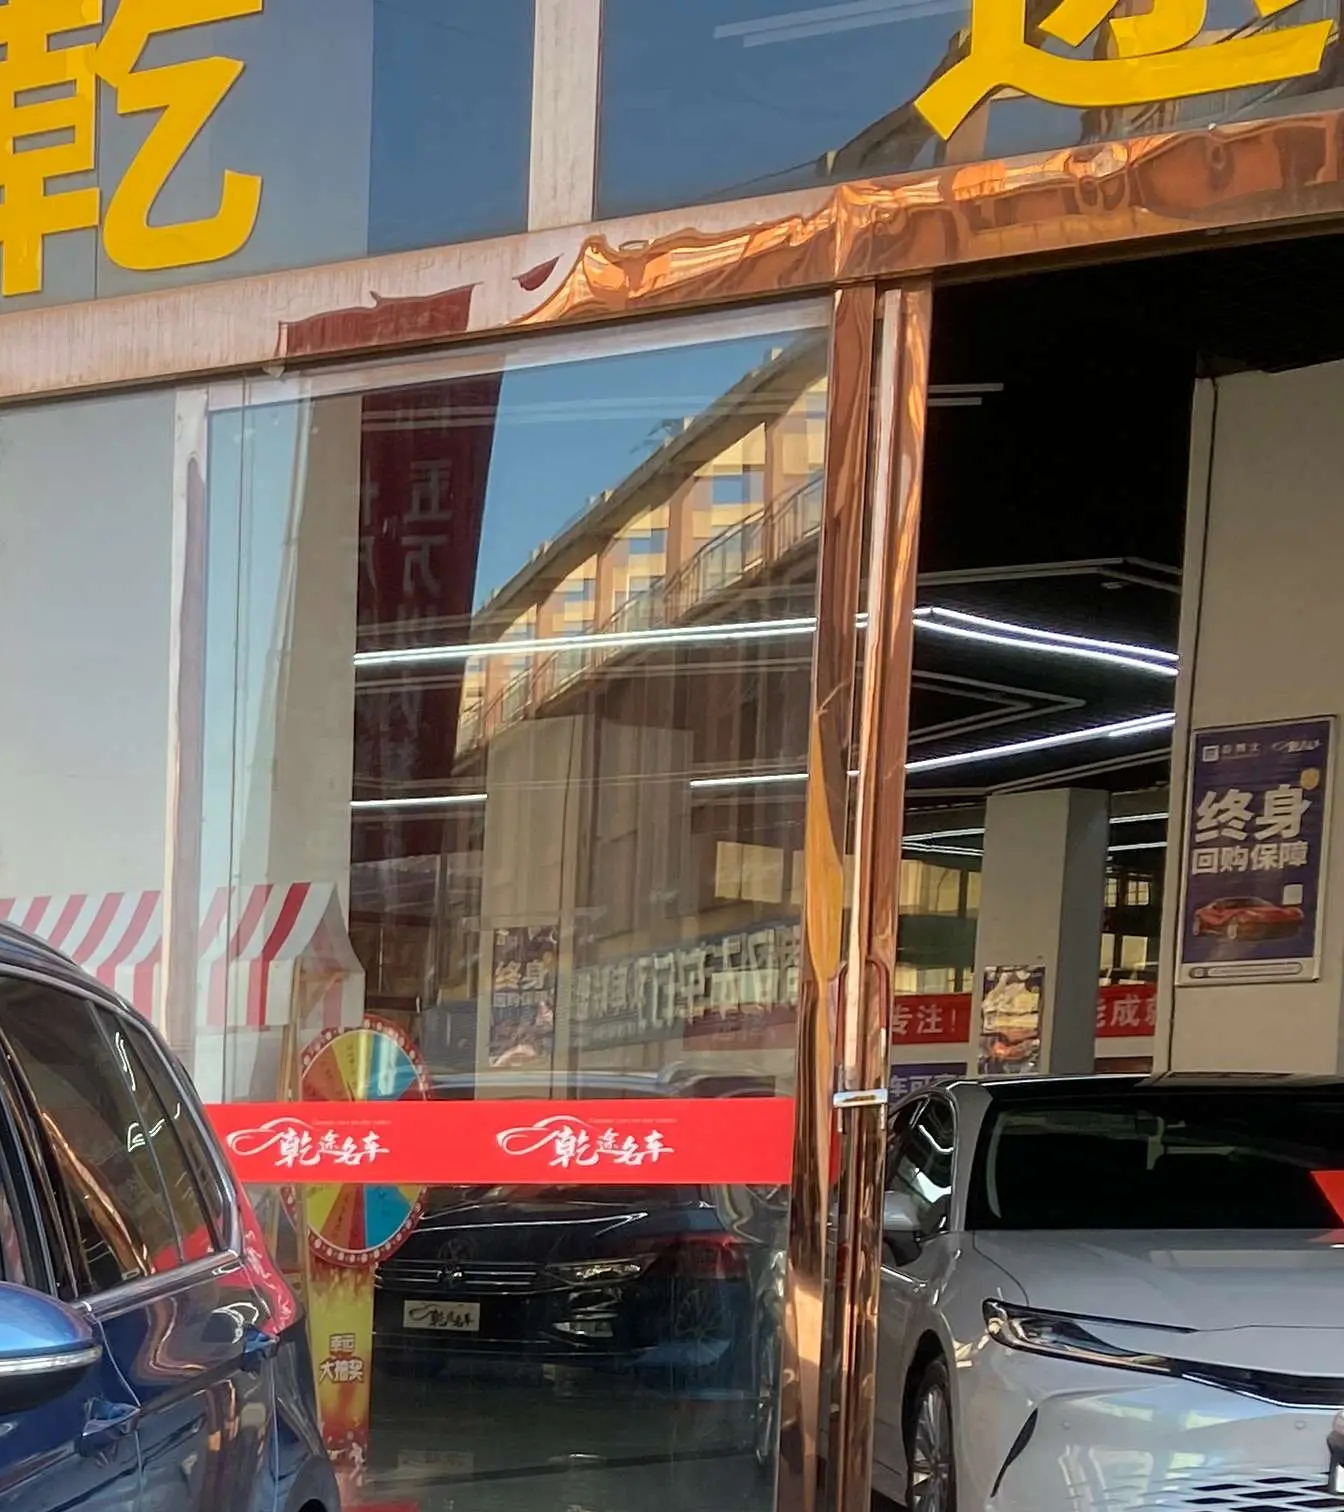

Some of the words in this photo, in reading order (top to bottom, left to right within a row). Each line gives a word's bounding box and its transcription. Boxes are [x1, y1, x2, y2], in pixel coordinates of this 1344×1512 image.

[1195, 783, 1311, 844] 终身
[1191, 842, 1309, 877] 回购保障
[274, 1126, 391, 1169] 乾途名车
[548, 1124, 676, 1169] 乾途名车
